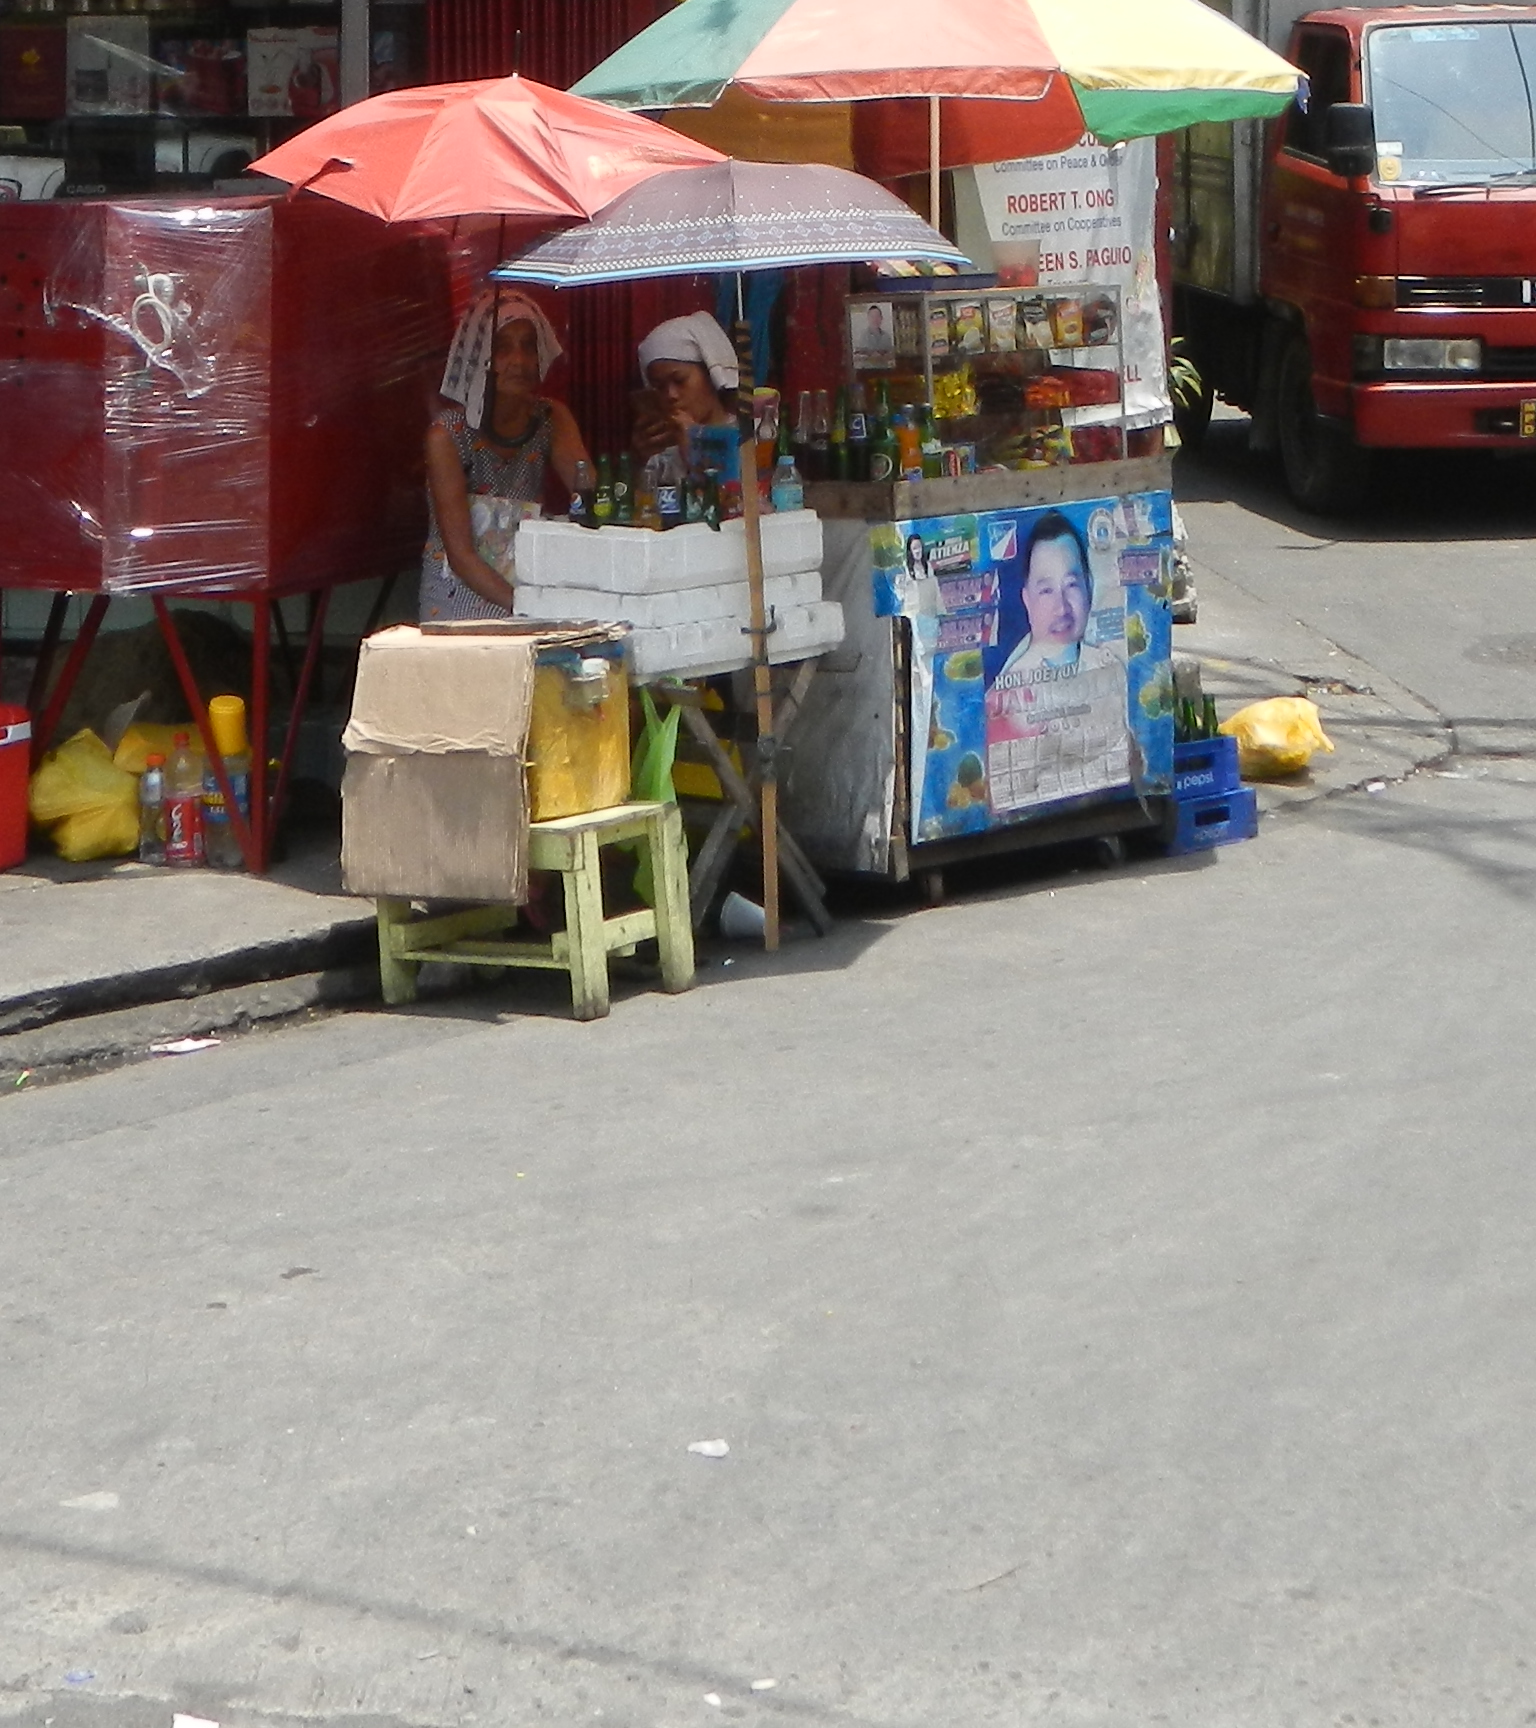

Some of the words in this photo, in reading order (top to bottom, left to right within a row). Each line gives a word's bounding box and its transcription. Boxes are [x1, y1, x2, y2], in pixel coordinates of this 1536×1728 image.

[1046, 158, 1058, 171] on
[1060, 155, 1089, 170] Peace
[1090, 154, 1097, 167] &
[66, 184, 107, 195] CASIO
[1007, 192, 1067, 214] ROBERT
[1070, 191, 1082, 210] T.
[1086, 188, 1115, 209] ONG
[1001, 220, 1051, 236] Committee
[1054, 220, 1065, 231] on
[1068, 250, 1083, 269] S.
[1086, 246, 1132, 268] PAGUIO
[929, 541, 970, 561] ATIENZA
